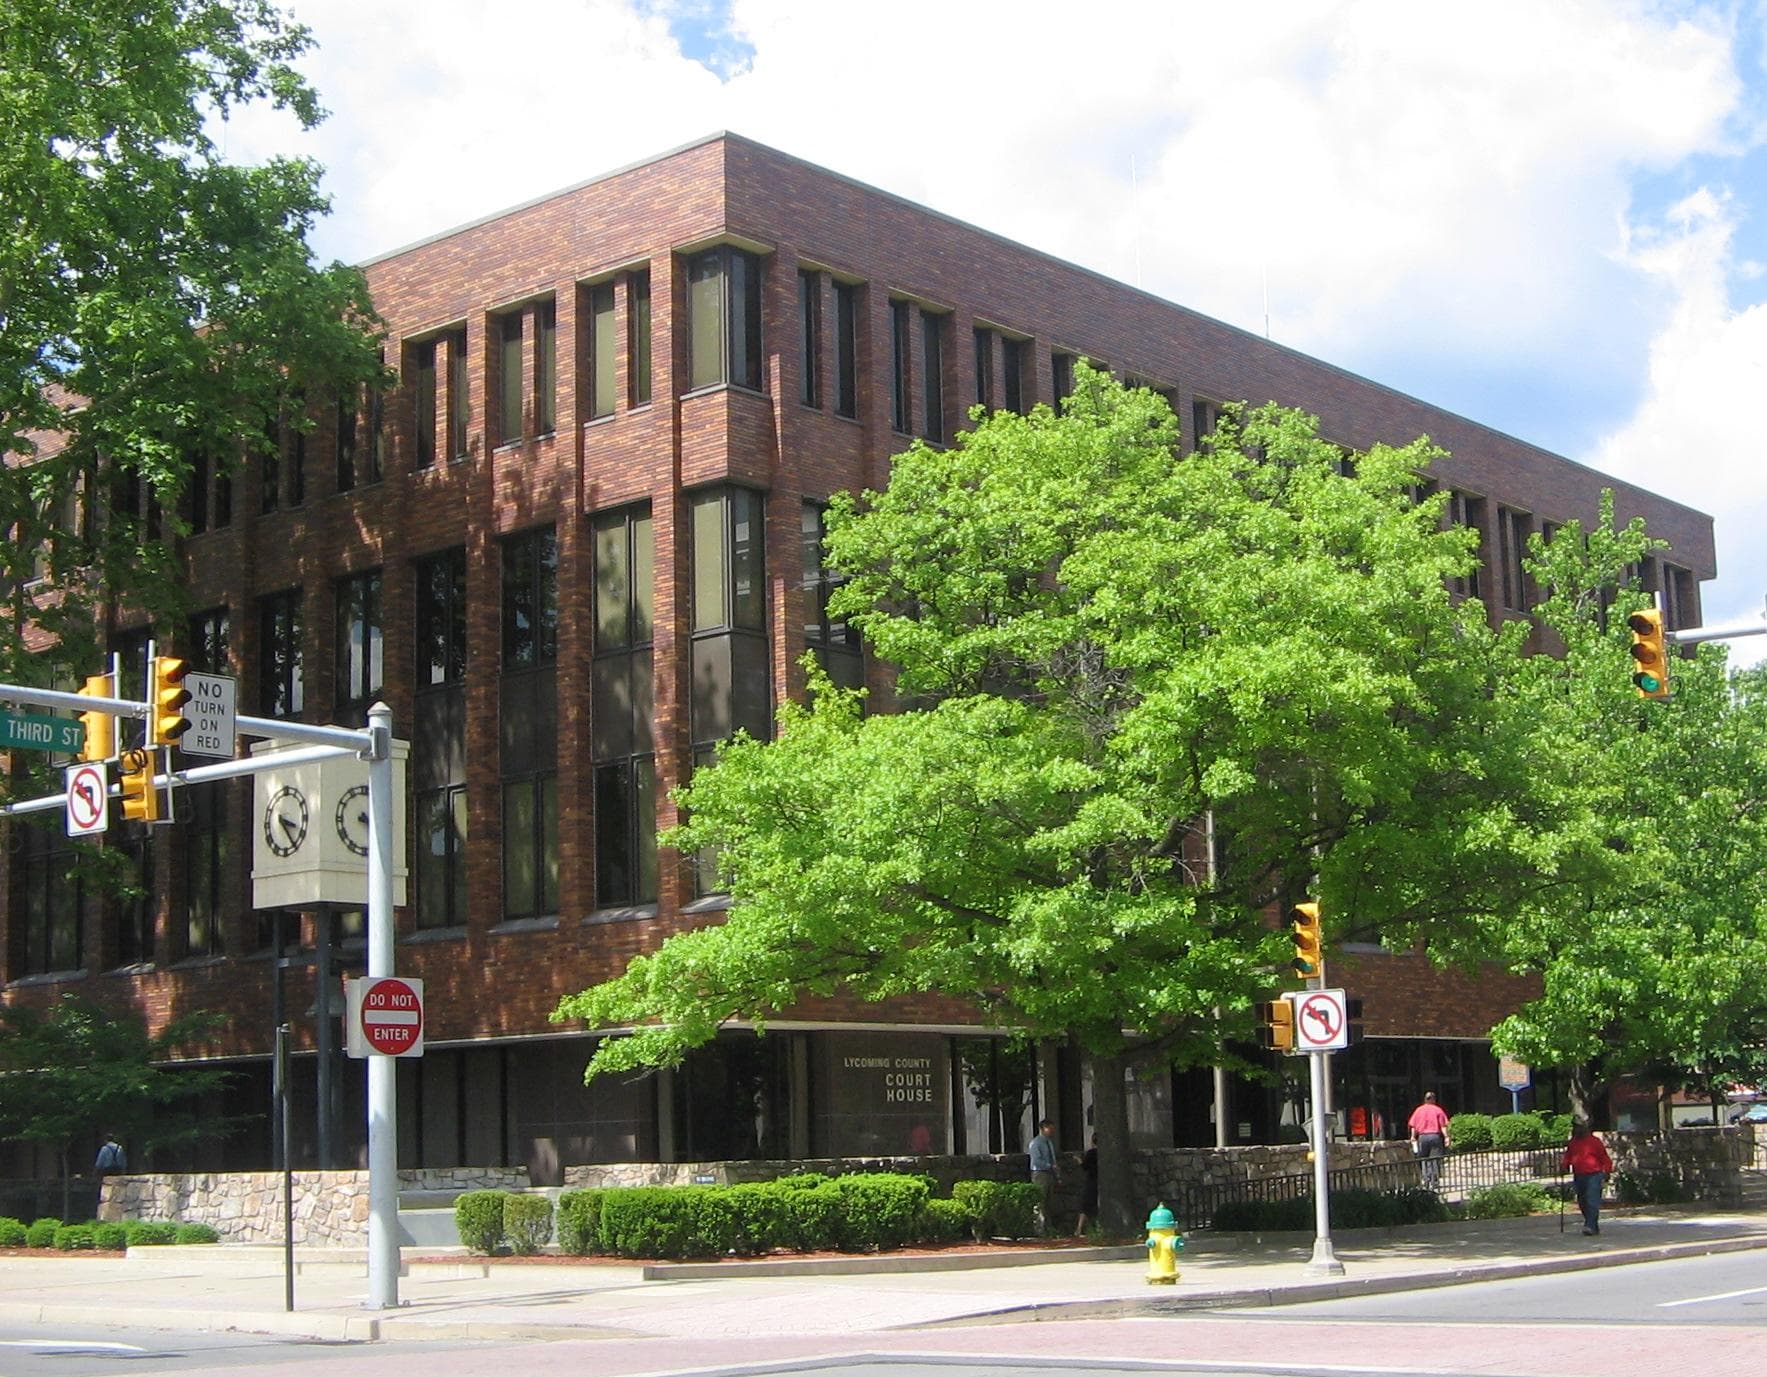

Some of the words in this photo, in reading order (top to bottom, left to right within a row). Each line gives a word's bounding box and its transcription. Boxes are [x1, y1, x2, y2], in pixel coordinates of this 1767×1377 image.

[198, 681, 222, 698] NO
[194, 700, 225, 716] TURN
[200, 719, 218, 731] ON
[8, 719, 53, 743] THIRD
[62, 726, 80, 746] ST
[197, 735, 220, 749] RED
[370, 994, 385, 1006] DO
[391, 994, 413, 1007] NOT
[374, 1028, 409, 1040] ENTER
[844, 1057, 890, 1068] LYCOMING
[895, 1057, 931, 1069] COUNTY
[885, 1073, 931, 1086] COURT
[886, 1089, 932, 1102] HOUSE
